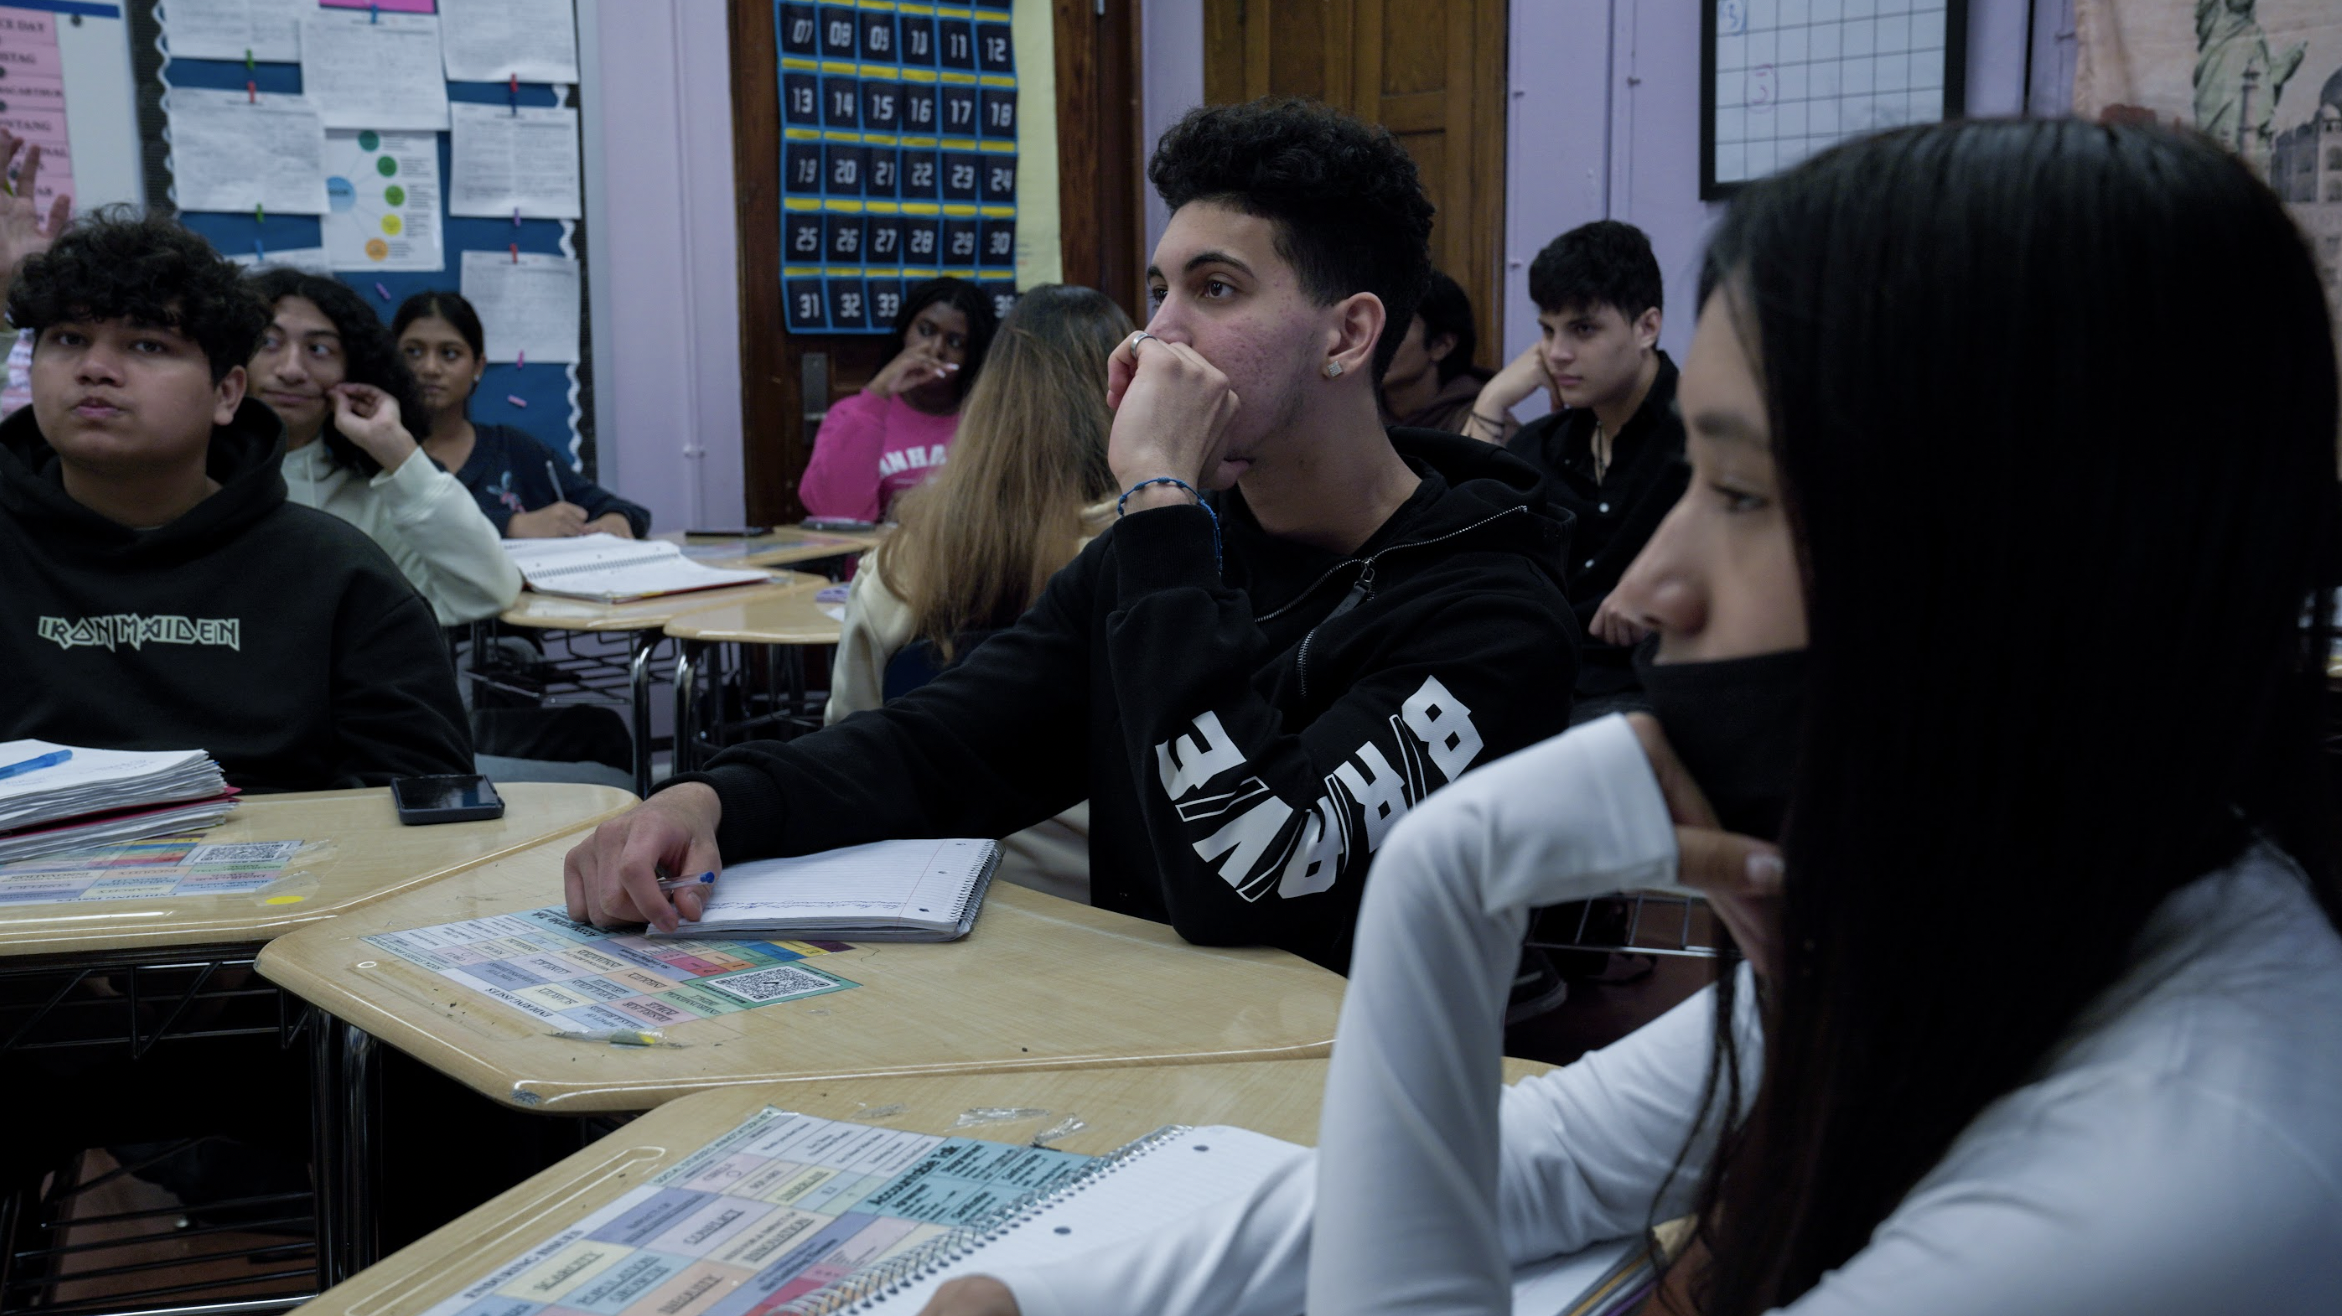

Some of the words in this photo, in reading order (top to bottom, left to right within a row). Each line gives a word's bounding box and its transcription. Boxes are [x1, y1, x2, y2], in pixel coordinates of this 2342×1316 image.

[792, 19, 814, 44] 07
[949, 33, 968, 59] 11
[986, 37, 1006, 63] 12
[793, 87, 813, 114] 13
[834, 91, 854, 118] 14
[872, 95, 894, 121] 15
[910, 97, 933, 123] 16
[950, 99, 973, 125] 17
[990, 102, 1013, 128] 18
[798, 158, 817, 184] 19
[834, 159, 857, 185] 20
[874, 161, 894, 187] 21
[911, 162, 933, 187] 22
[951, 164, 974, 190] 23
[990, 167, 1013, 192] 24
[795, 227, 818, 252] 25
[835, 228, 859, 253] 26
[874, 228, 897, 253] 27
[910, 229, 934, 254] 28
[951, 231, 974, 256] 29
[989, 231, 1011, 256] 30
[799, 292, 820, 319] 31
[840, 292, 861, 319] 32
[877, 293, 900, 318] 33
[38, 615, 116, 653] IRON
[115, 613, 240, 651] MAIDEN
[528, 958, 572, 974] CONFLICT
[621, 972, 668, 988] INEQUITY
[482, 987, 515, 999] ISSUES
[532, 987, 579, 1005] SCARCITY
[565, 979, 621, 999] POPULATION
[505, 998, 555, 1017] ENDURING
[618, 1001, 645, 1010] FOR
[633, 1008, 673, 1022] DESIRE
[642, 1002, 680, 1015] POWER
[747, 1170, 783, 1189] SQUARE
[865, 1158, 942, 1206] Accountable
[928, 1143, 963, 1160] Talk
[889, 1182, 932, 1208] Agreement
[679, 1208, 746, 1245] CONFLICT
[740, 1216, 816, 1263] INNOVATION
[461, 1254, 541, 1299] ENDURING
[533, 1227, 586, 1256] ISSUES
[528, 1248, 606, 1292] SCARCITY
[572, 1253, 663, 1307] POPULATION
[605, 1264, 673, 1303] GROWTH
[655, 1273, 724, 1315] INEQUITY
